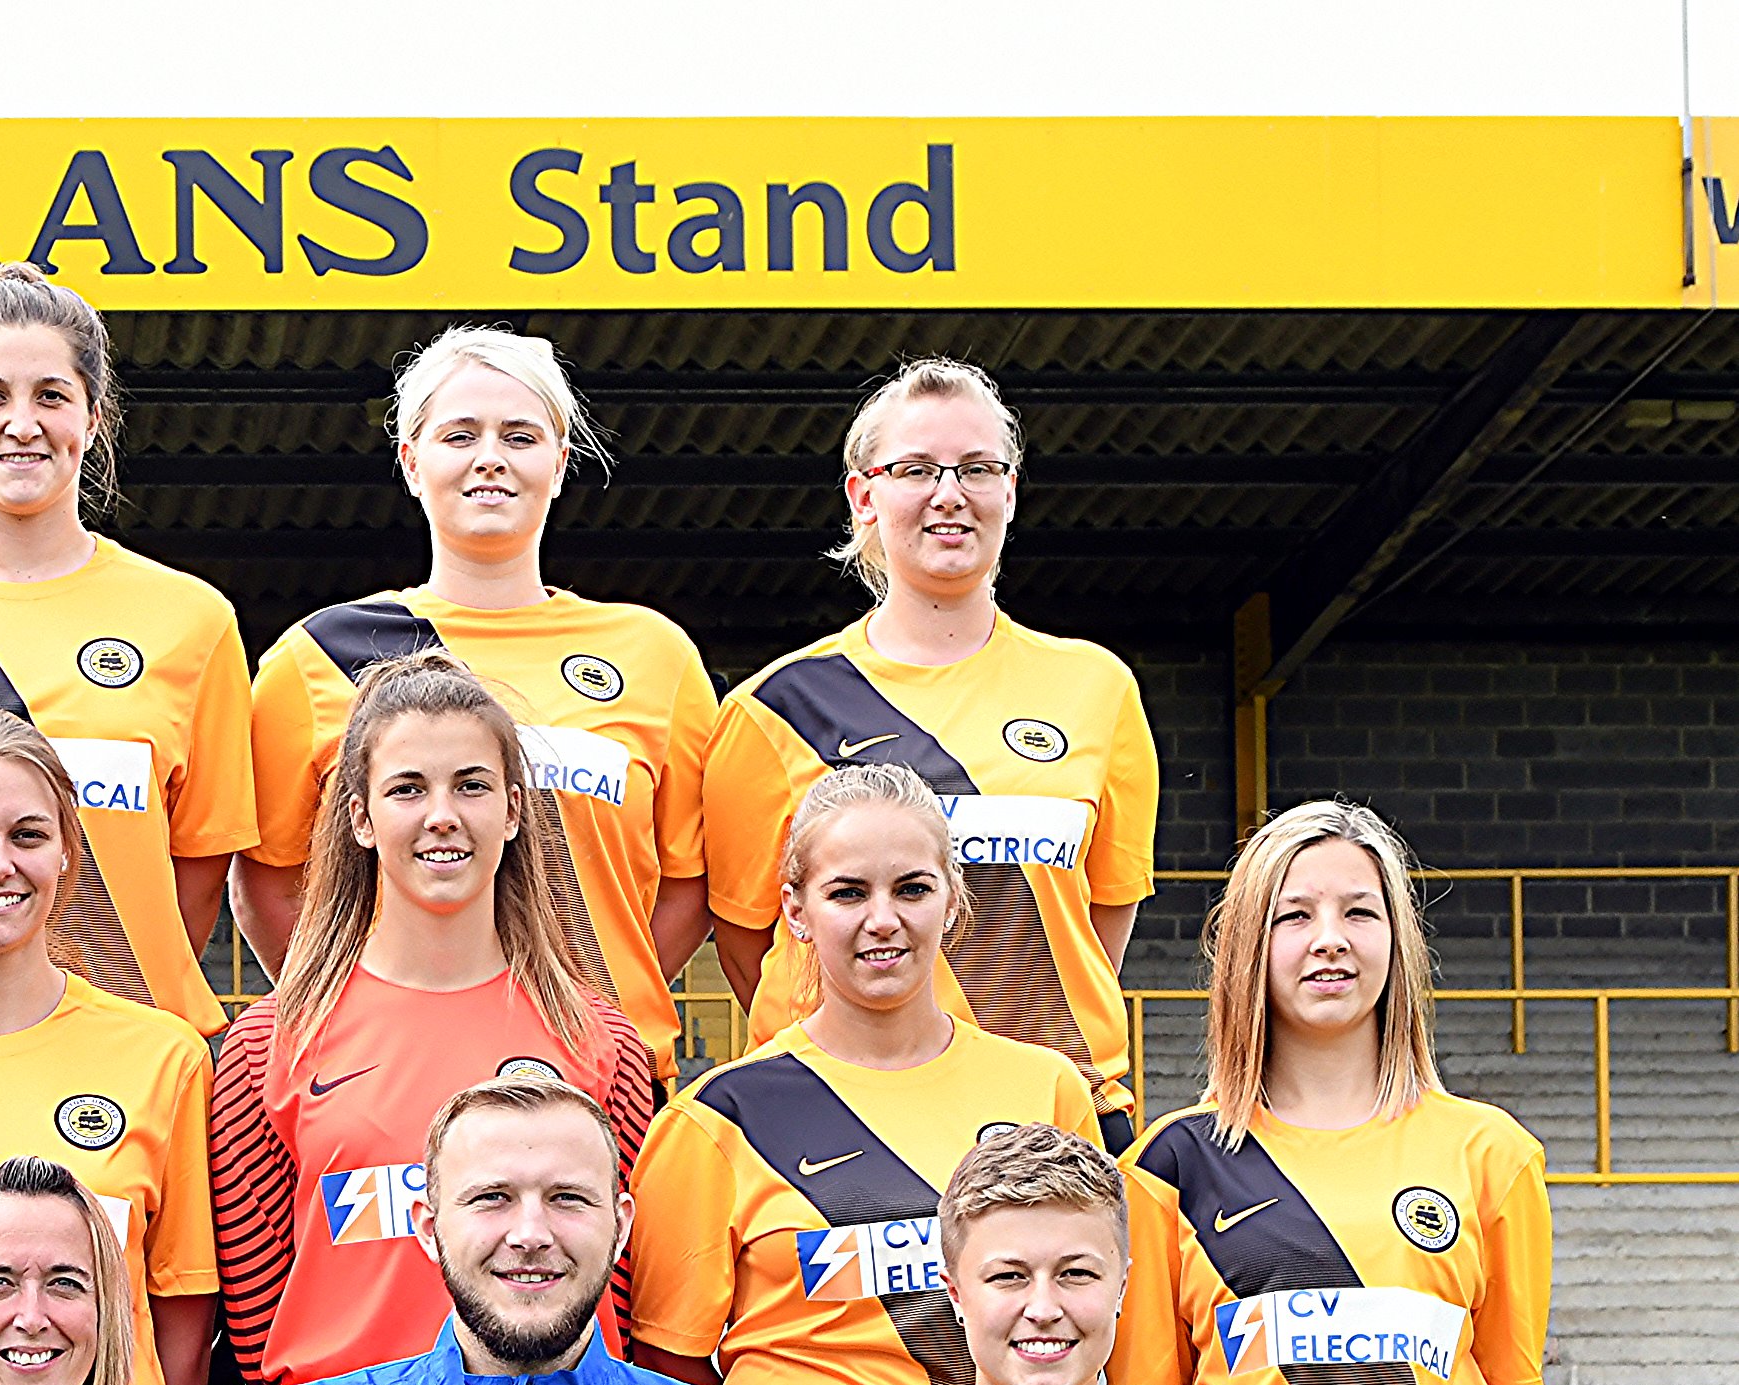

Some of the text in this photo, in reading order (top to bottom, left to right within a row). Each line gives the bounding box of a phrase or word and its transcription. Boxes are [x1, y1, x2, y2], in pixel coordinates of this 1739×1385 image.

[508, 144, 955, 274] Stand
[883, 1219, 933, 1249] CV
[1288, 1290, 1340, 1318] CV
[1292, 1333, 1448, 1379] ELECTRICAL
